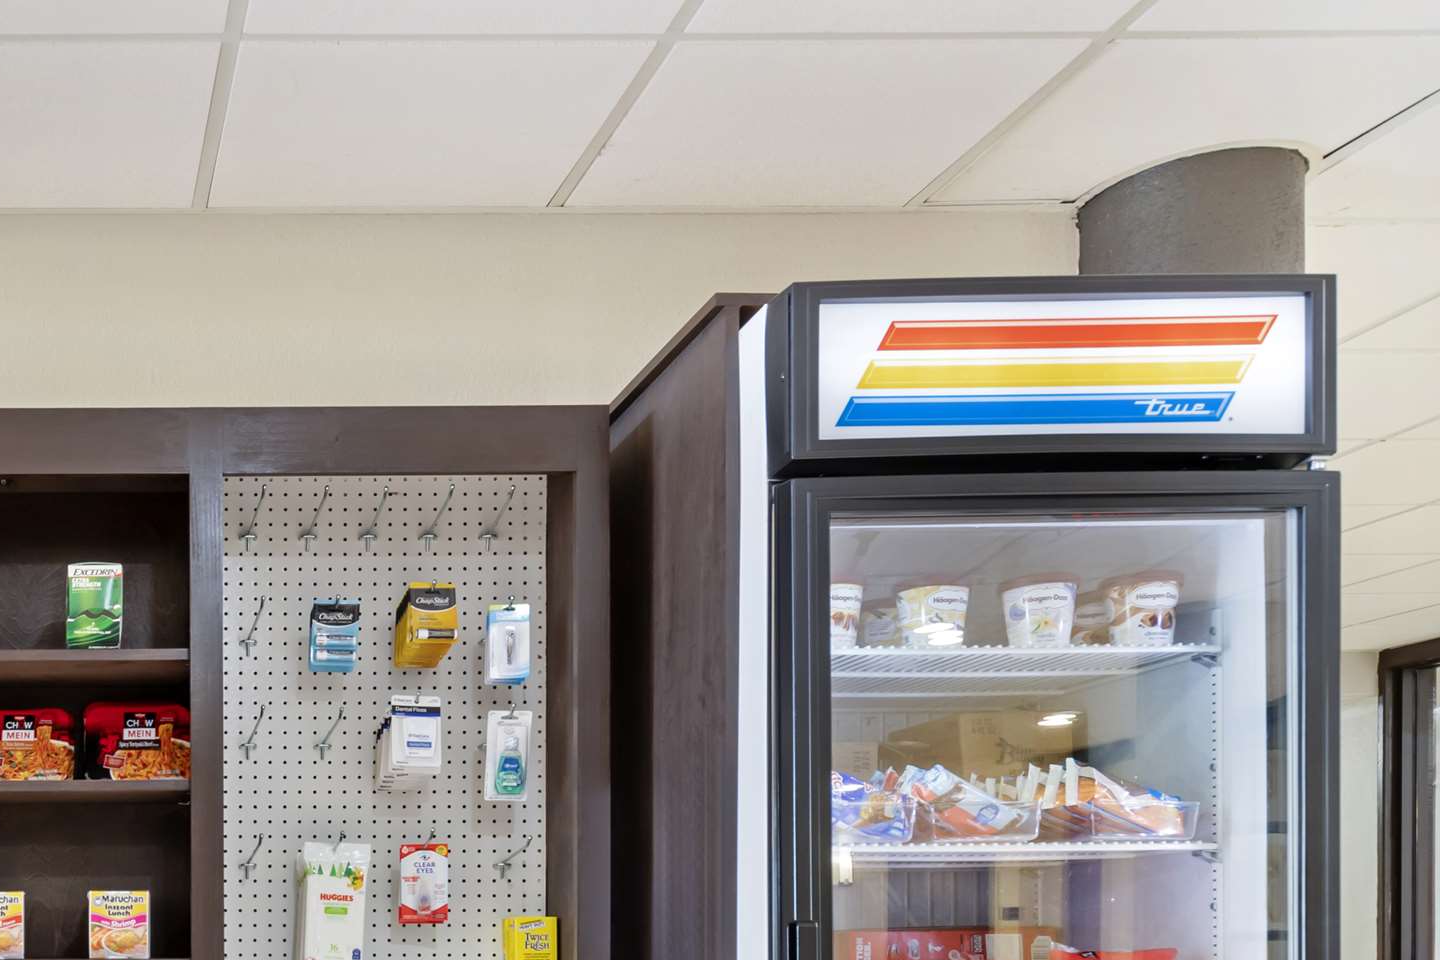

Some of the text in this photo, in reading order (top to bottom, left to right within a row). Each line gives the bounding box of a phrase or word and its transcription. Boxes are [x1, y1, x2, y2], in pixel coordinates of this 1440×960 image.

[1134, 398, 1210, 415] true
[102, 895, 144, 903] Maruchan
[320, 893, 354, 902] HUGGIES
